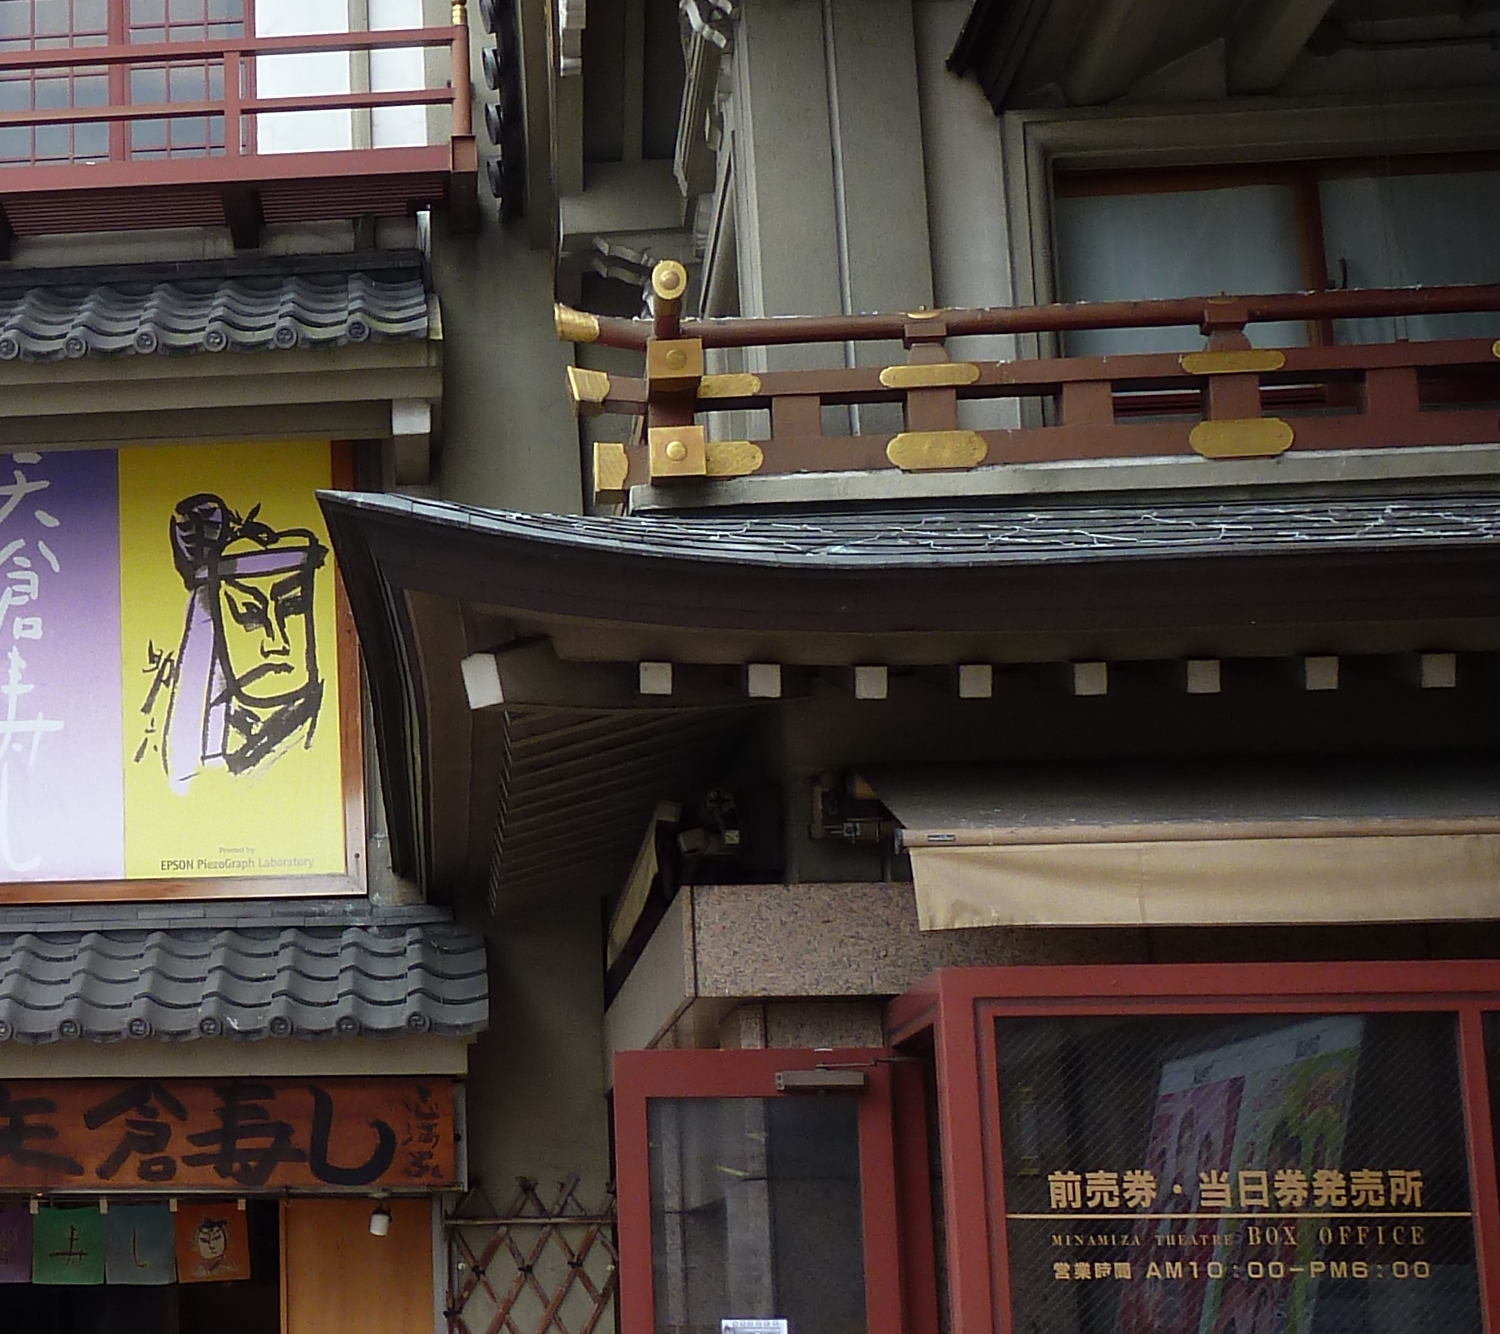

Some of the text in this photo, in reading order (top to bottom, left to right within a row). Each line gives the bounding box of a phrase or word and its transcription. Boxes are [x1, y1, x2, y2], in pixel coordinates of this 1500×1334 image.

[160, 857, 315, 871] EPSON PiezoGraph Laboratory
[1047, 1170, 1423, 1208] 前売券・当日券発売所
[1051, 1226, 1425, 1246] MINAMIZA THEATRE BOX OFFICE
[1053, 1261, 1131, 1280] 営業時間
